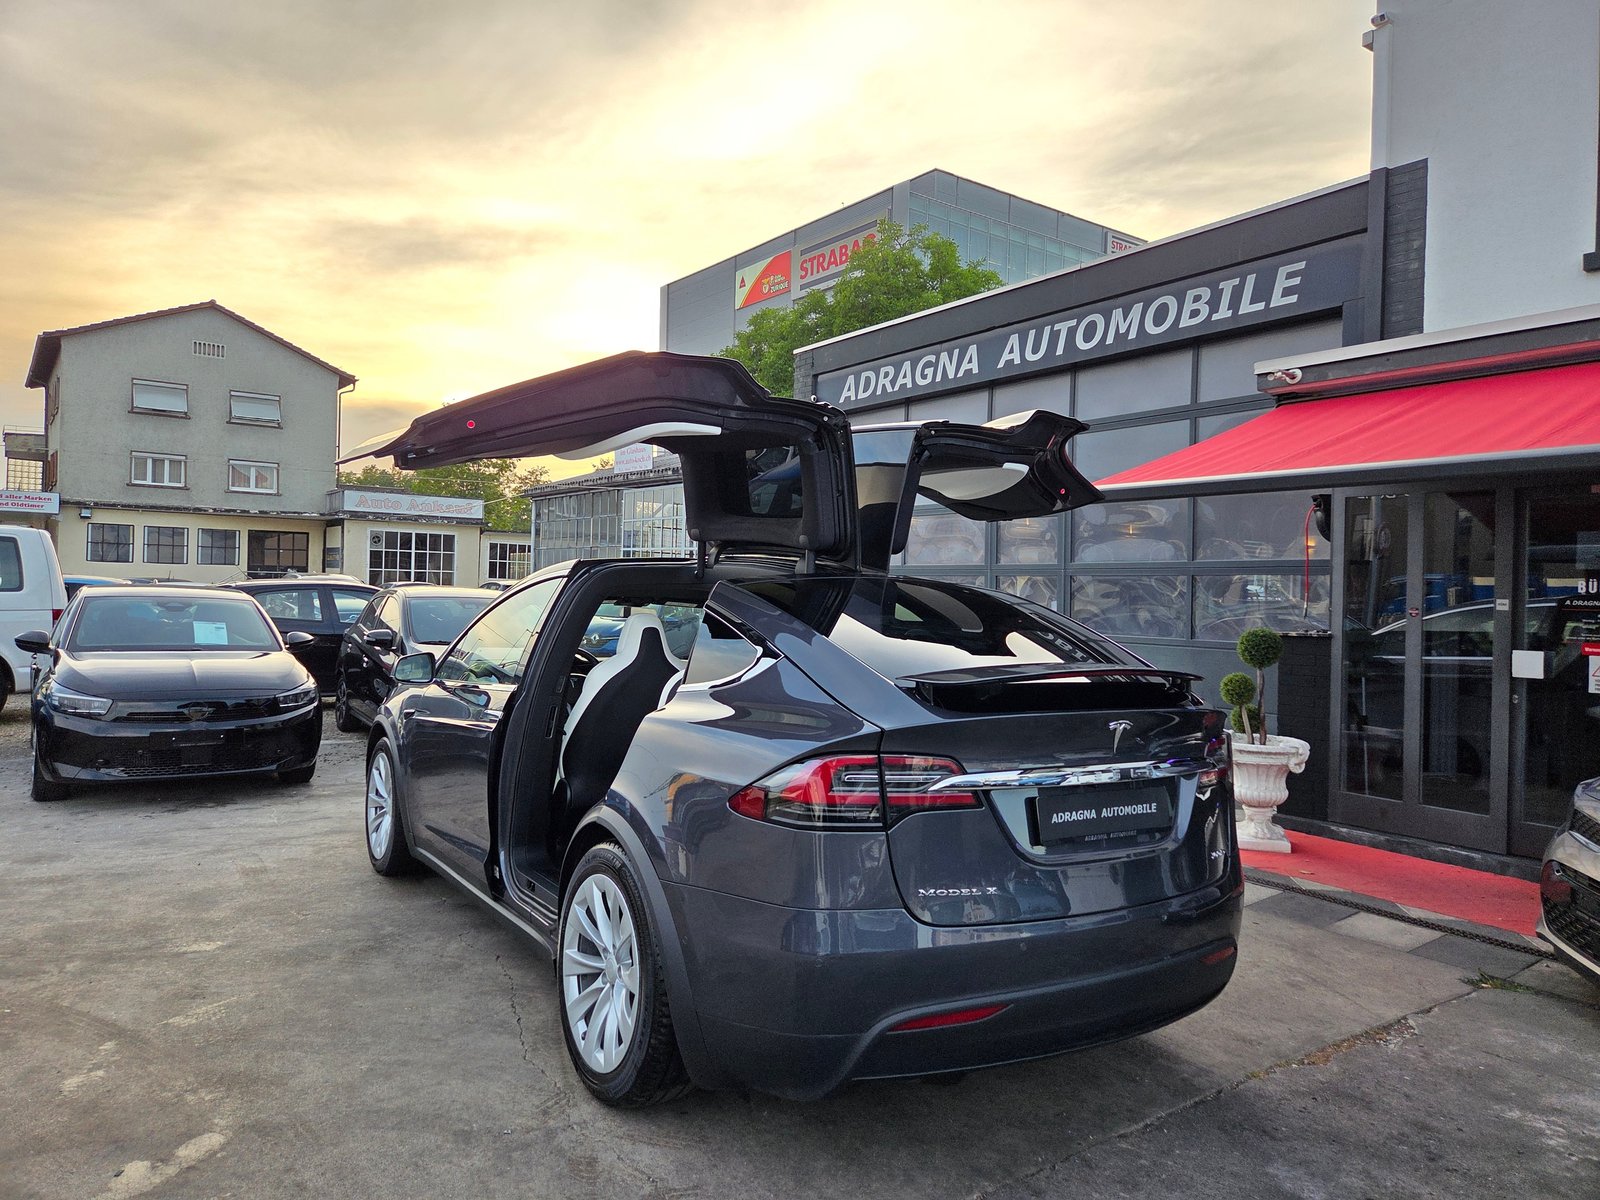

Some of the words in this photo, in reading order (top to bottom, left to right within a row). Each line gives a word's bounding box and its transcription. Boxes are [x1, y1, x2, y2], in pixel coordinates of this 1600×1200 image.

[1111, 239, 1133, 252] STRA
[838, 343, 980, 404] ADRAGNA
[996, 260, 1306, 369] AUTOMOBILE
[11, 501, 45, 509] Oldtimer
[355, 494, 403, 511] Auto
[406, 499, 474, 516] Ankauf
[1577, 579, 1600, 593] BÜ
[1051, 808, 1097, 824] ADRAGNA
[1101, 802, 1157, 818] AUTOMOBILE
[918, 888, 982, 897] MODEL
[986, 886, 998, 895] X
